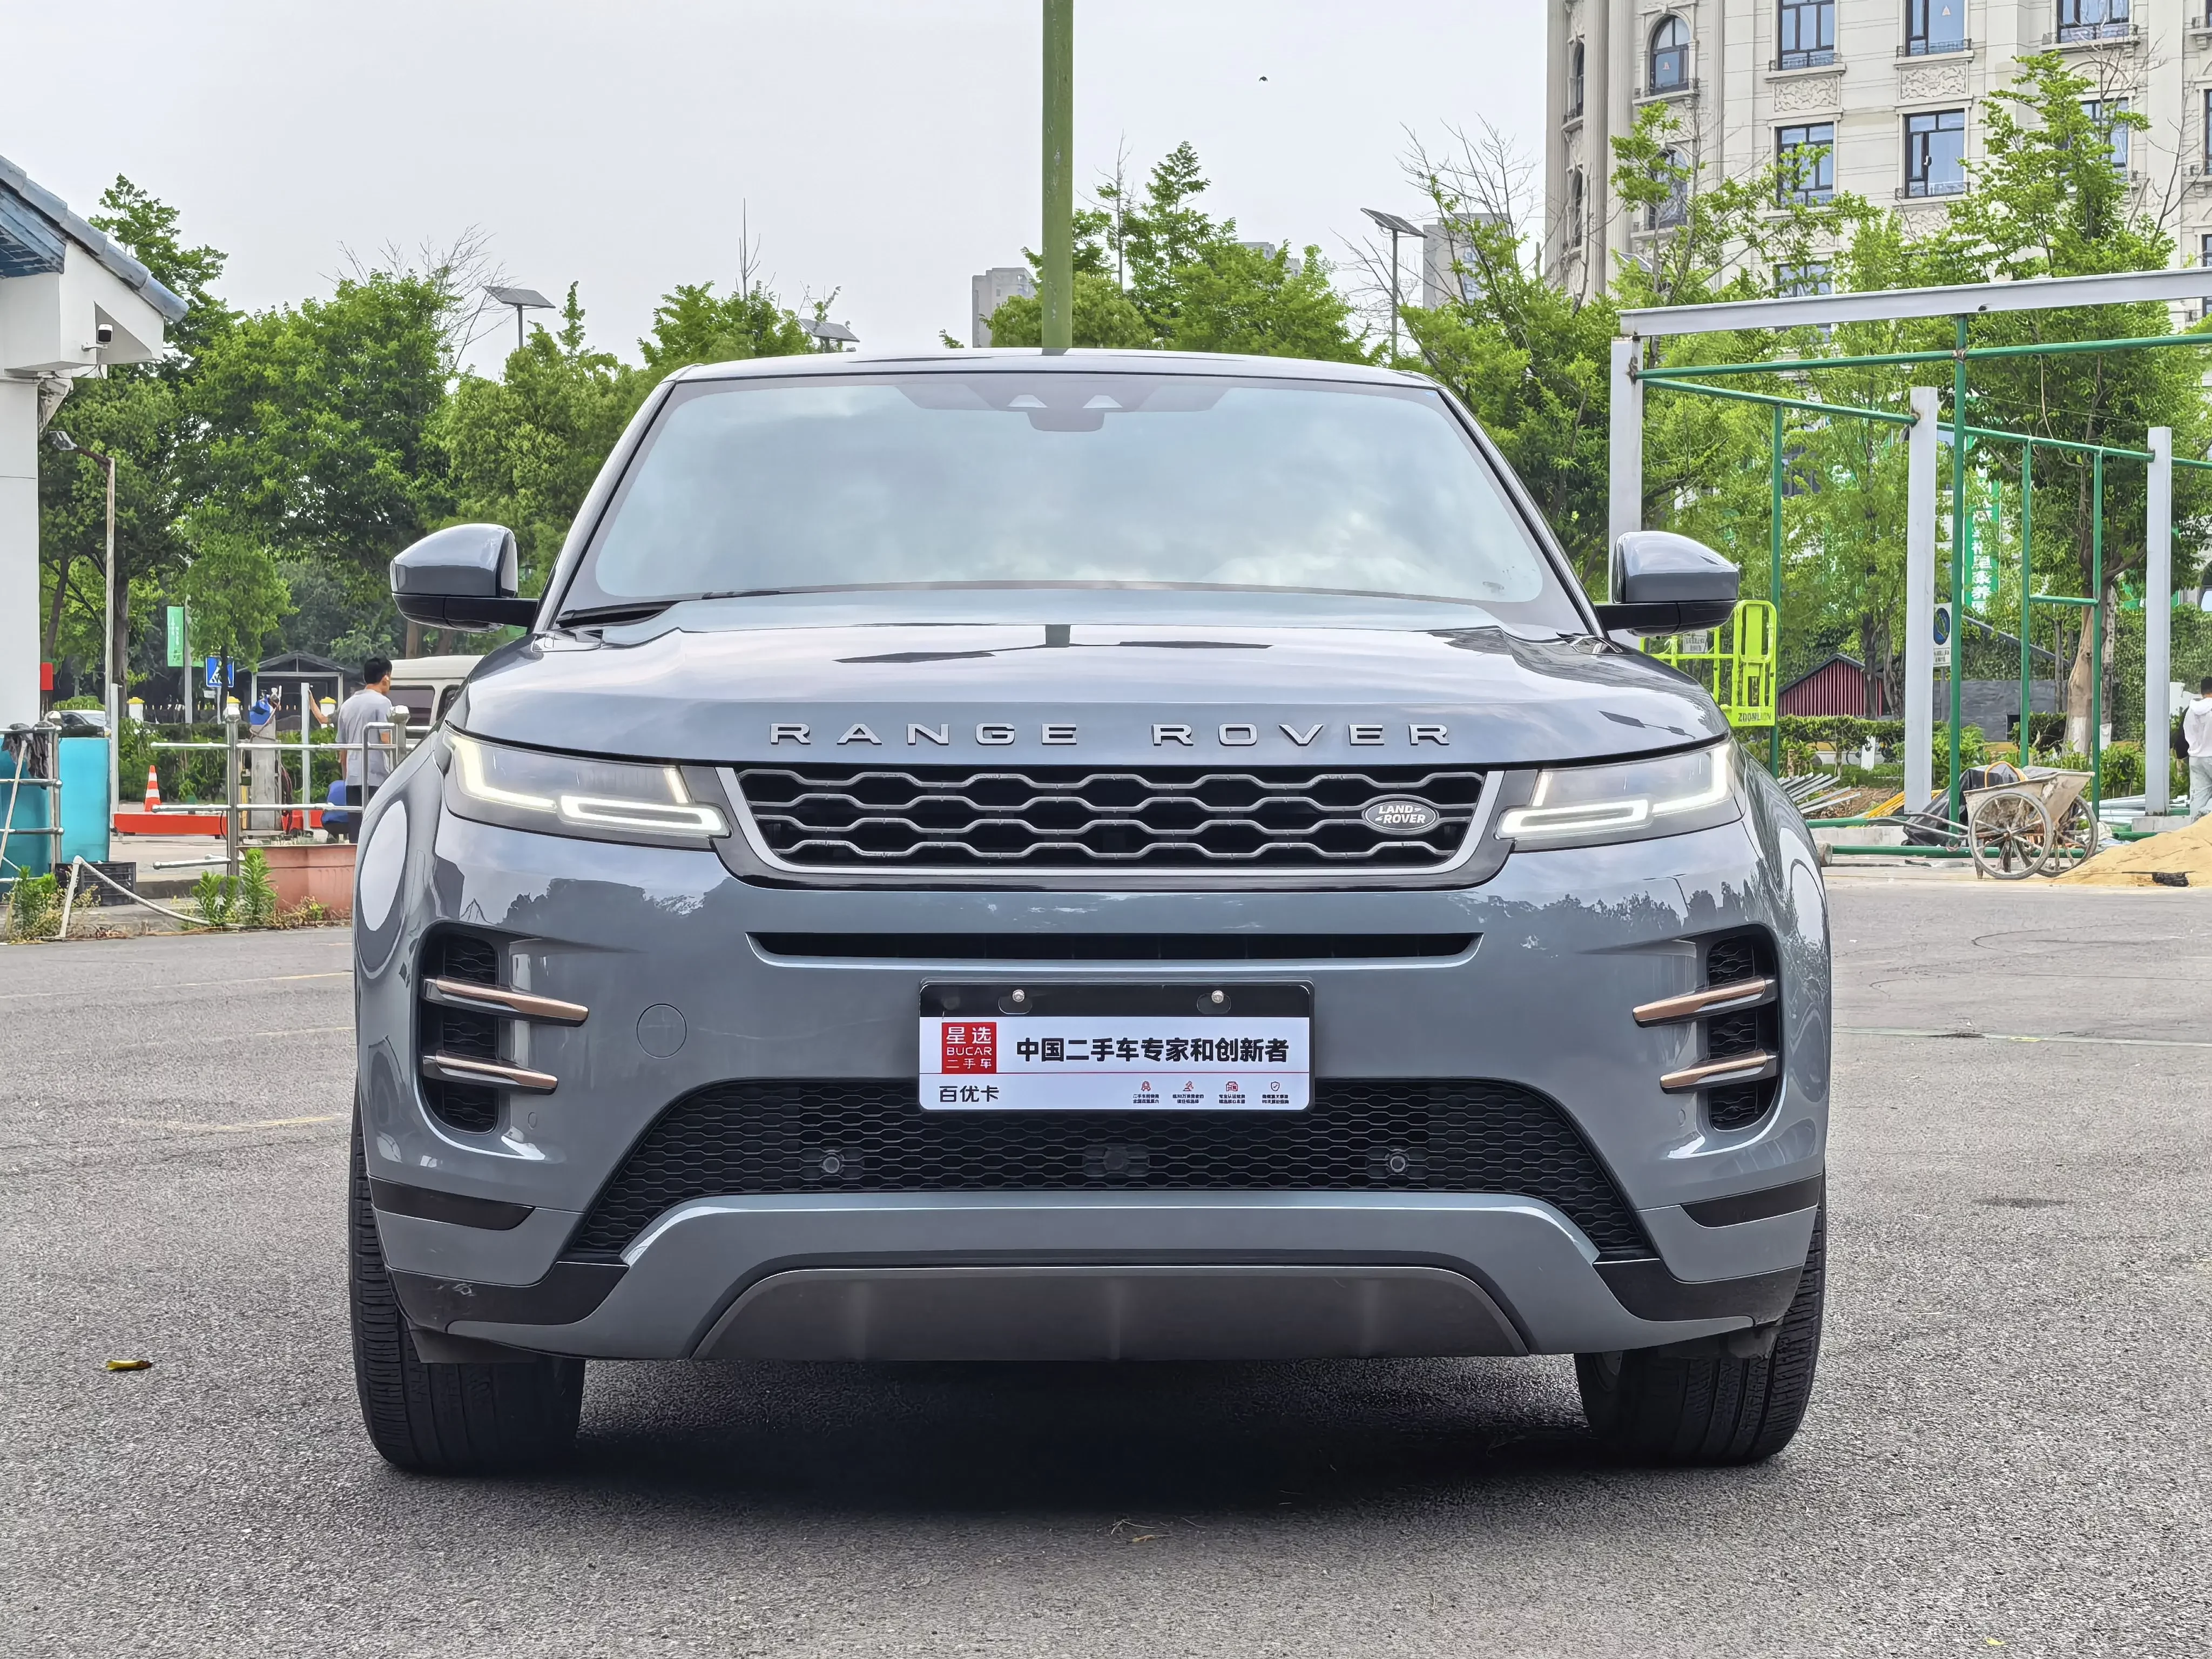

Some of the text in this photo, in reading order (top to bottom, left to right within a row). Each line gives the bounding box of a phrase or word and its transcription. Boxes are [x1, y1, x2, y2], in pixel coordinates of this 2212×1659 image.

[770, 723, 1451, 746] RANGE ROVER
[1378, 805, 1414, 814] LAND
[1382, 814, 1426, 824] ROVER
[946, 1026, 992, 1044] 星选
[946, 1047, 992, 1056] BUCAR
[1016, 1037, 1290, 1063] 中国二手车专家和创新者
[946, 1058, 992, 1069] 二手车
[939, 1085, 1000, 1103] 百优卡
